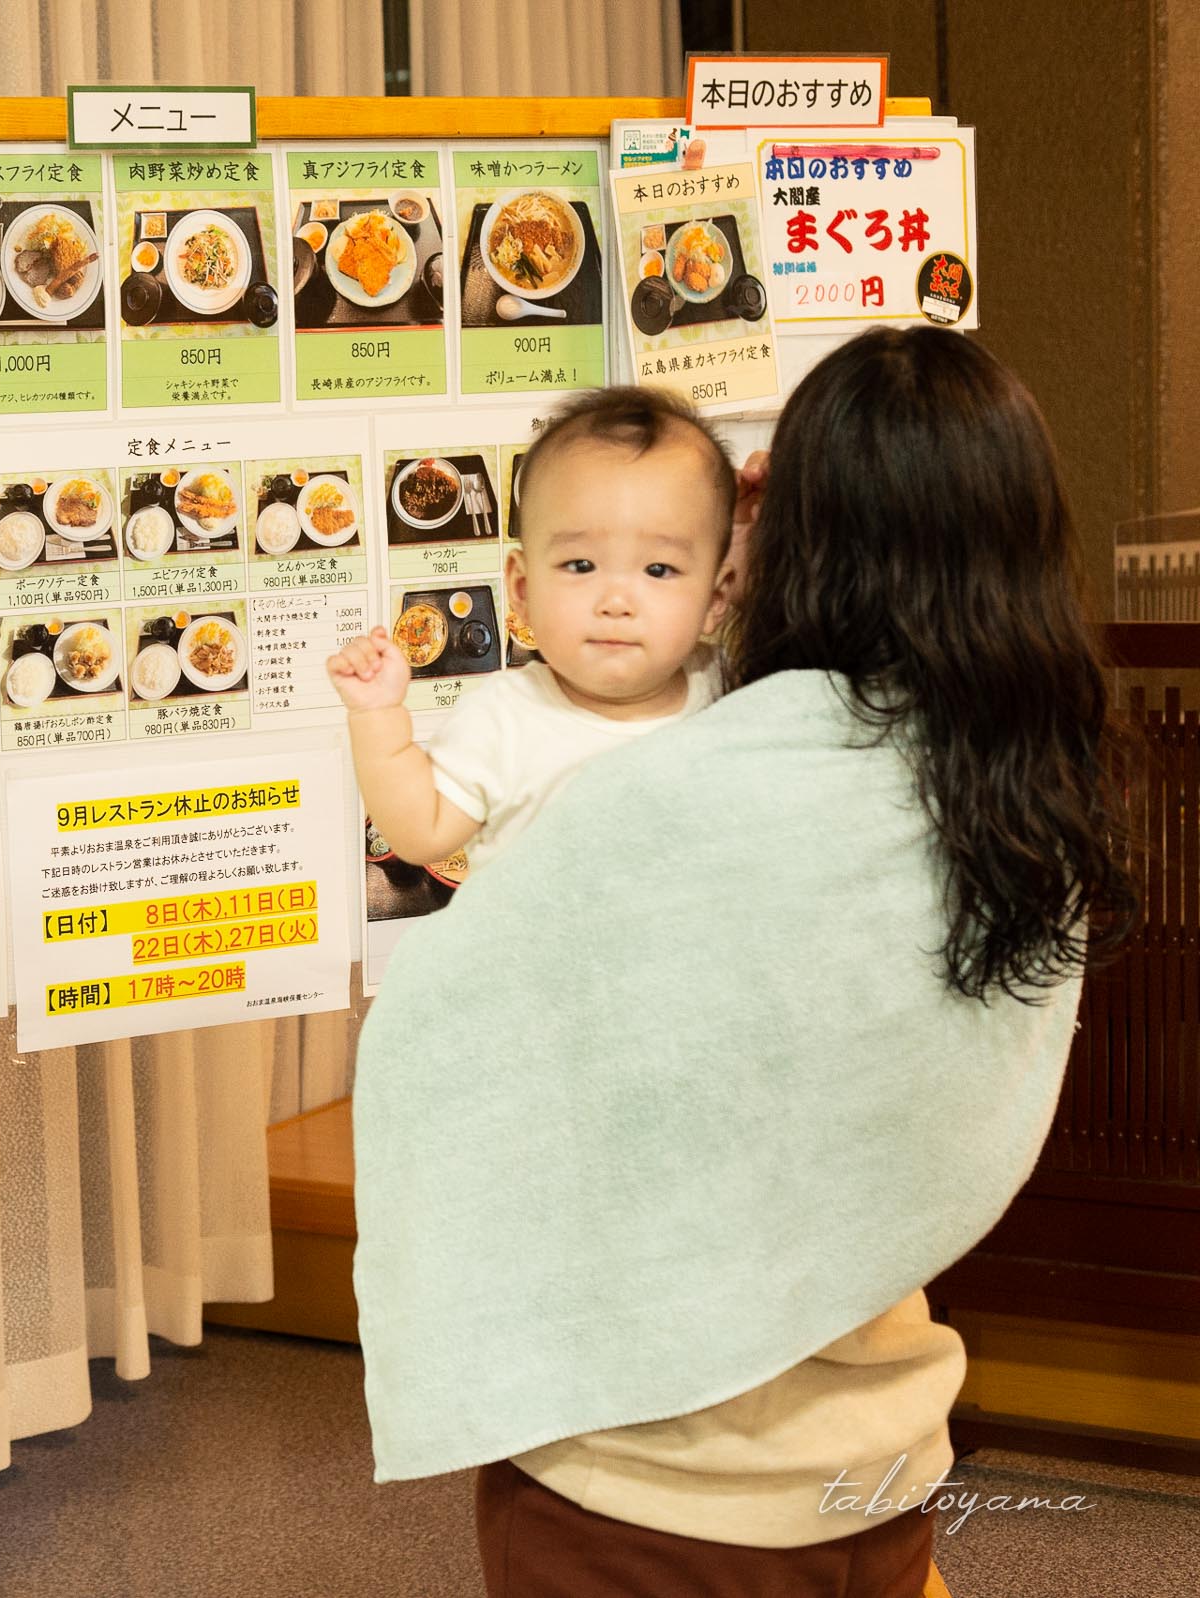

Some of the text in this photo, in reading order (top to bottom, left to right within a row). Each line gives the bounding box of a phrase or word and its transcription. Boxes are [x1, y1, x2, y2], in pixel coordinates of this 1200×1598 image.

[701, 78, 872, 109] 本日のおすすめ
[110, 103, 216, 132] メニュー
[128, 160, 260, 182] 肉野菜炒め定食
[302, 159, 426, 180] 真アジフライ定食
[470, 159, 583, 178] 味噌かつラーメン
[765, 156, 912, 180] 本日のおすすめ
[633, 174, 741, 202] 本日のおすすめ
[773, 186, 821, 206] 大間産
[786, 207, 931, 253] まぐろ丼
[796, 276, 884, 307] 2000円
[351, 342, 391, 358] 850円
[513, 337, 552, 353] 900円
[180, 348, 222, 366] 850円
[641, 343, 772, 377] 広島県産カキフライ定食
[165, 378, 239, 391] シャキシャキ野菜で
[311, 373, 431, 391] 長崎県産のアジフライです。
[486, 368, 578, 386] ボリューム満点！
[171, 389, 233, 402] 栄養満点です。
[692, 381, 729, 400] 850円
[127, 438, 231, 456] 定食メニュー
[423, 548, 467, 560] かつカレー
[152, 566, 219, 581] エビフライ定食
[277, 557, 338, 572] とんかつ定食
[433, 562, 458, 573] 780円
[16, 573, 100, 591] ポークソテー定食
[132, 579, 238, 598] 1,500円(単品1,300円)
[263, 571, 353, 588] 980円(単品830円)
[8, 588, 110, 607] 1,100円(単品950円)
[253, 594, 327, 611] 【その他メニュー】
[433, 680, 463, 692] かつ丼
[157, 703, 223, 720] 豚バラ焼定食
[14, 714, 113, 732] 鶏唐揚げおろしポン酢定食
[145, 719, 236, 735] 980円(単品830円)
[17, 728, 112, 747] 850円(単品700円)
[57, 784, 300, 828] 9月レストラン休止のお知らせ
[50, 822, 295, 858] 平素よりおおま温泉をご利用頂き誠にありがとうございます。
[41, 844, 281, 879] 下記日時のレストラン営業はお休みとさせていただきます。
[41, 860, 304, 899] ご迷惑をお掛け致しますが、ご理解の程よろしくお願い致します。
[45, 909, 108, 939] 【日付】
[48, 982, 111, 1012] 【時間】
